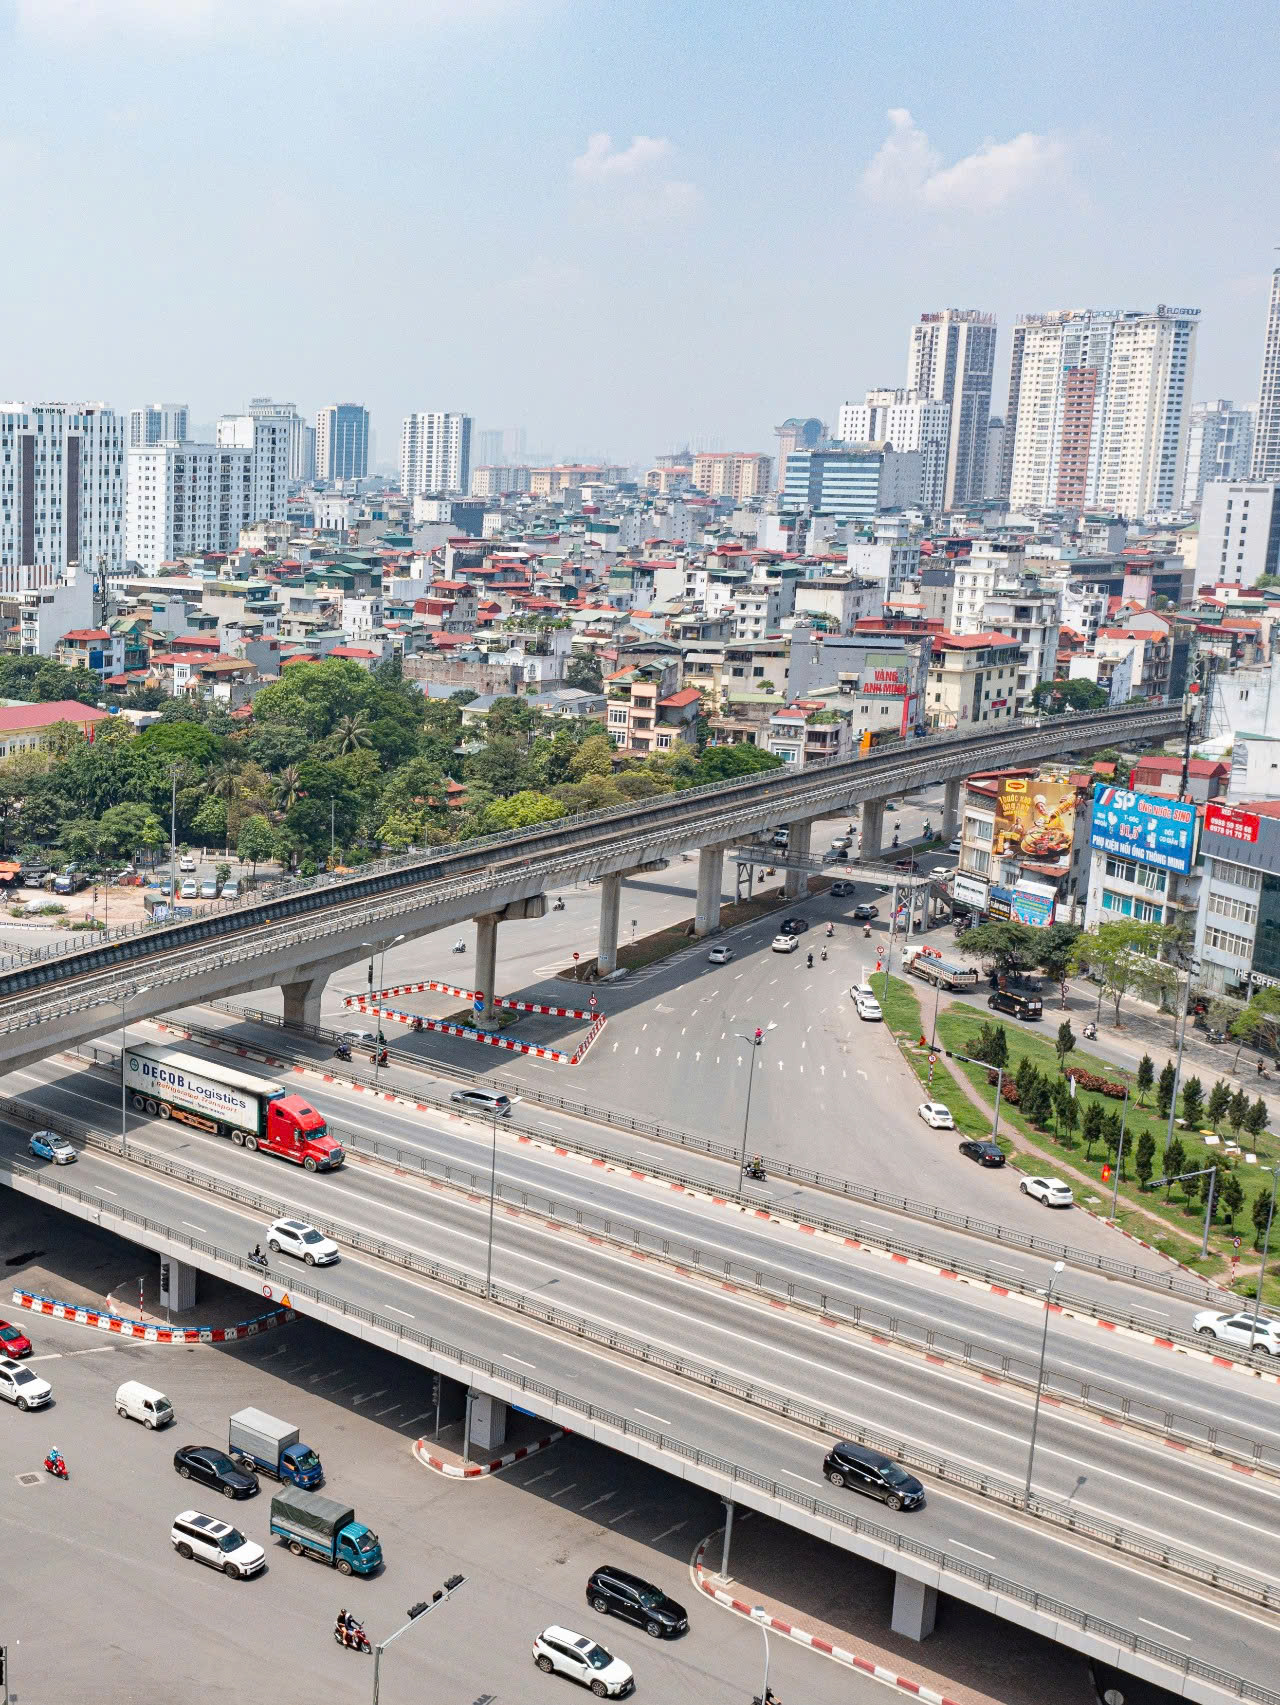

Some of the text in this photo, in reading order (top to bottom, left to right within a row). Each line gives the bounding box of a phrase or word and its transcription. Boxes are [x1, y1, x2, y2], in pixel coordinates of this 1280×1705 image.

[1179, 308, 1202, 316] GROUP
[874, 668, 899, 682] VÀNG
[863, 682, 882, 694] ANH
[1113, 791, 1136, 811] SP
[1138, 798, 1191, 824] ỐNG NƯỚC SINO
[1234, 831, 1242, 839] 70
[1092, 834, 1184, 870] PHỤ KIỆN NỐI ỐNG THÔNG MINH
[1234, 967, 1249, 981] THE
[187, 1081, 246, 1109] Logistics
[201, 1096, 238, 1113] Transport
